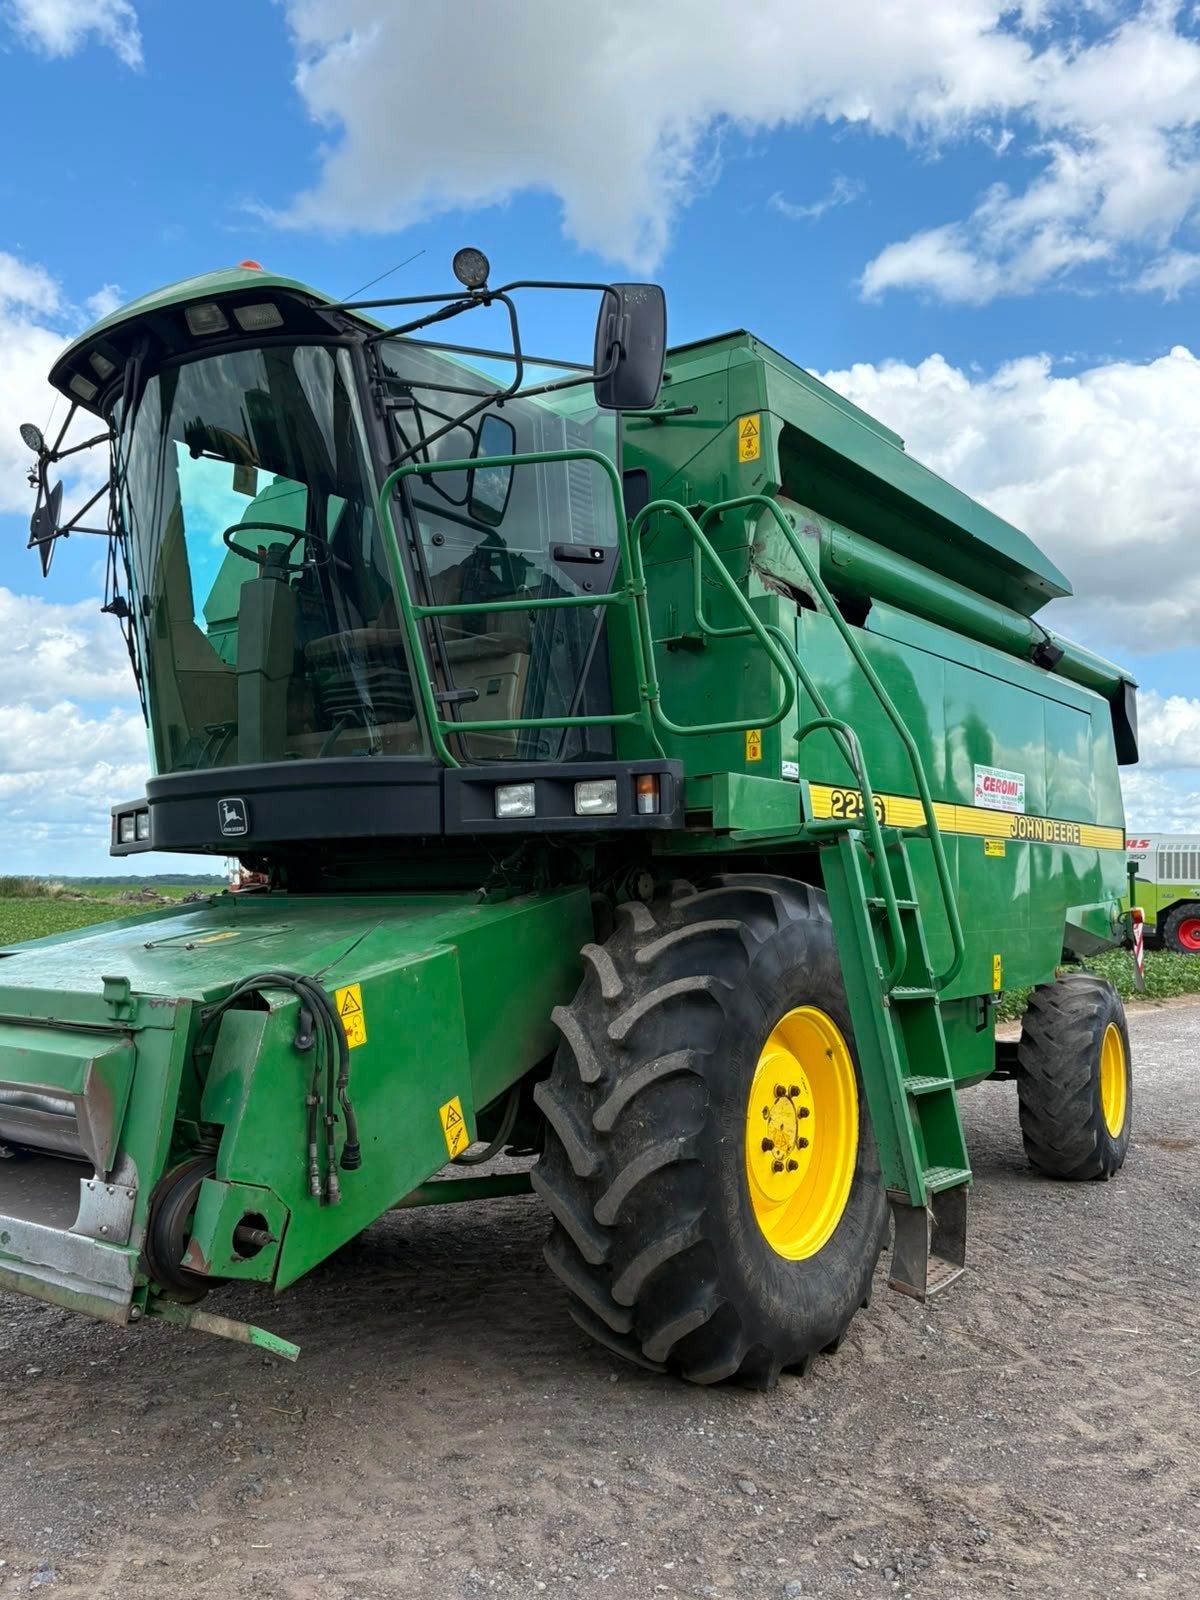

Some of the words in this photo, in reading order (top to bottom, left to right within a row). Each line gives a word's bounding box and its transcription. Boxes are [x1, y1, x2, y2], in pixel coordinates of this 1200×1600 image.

[983, 776, 1017, 796] GEROMI
[1010, 815, 1043, 841] JOHN
[1044, 820, 1081, 845] DEERE
